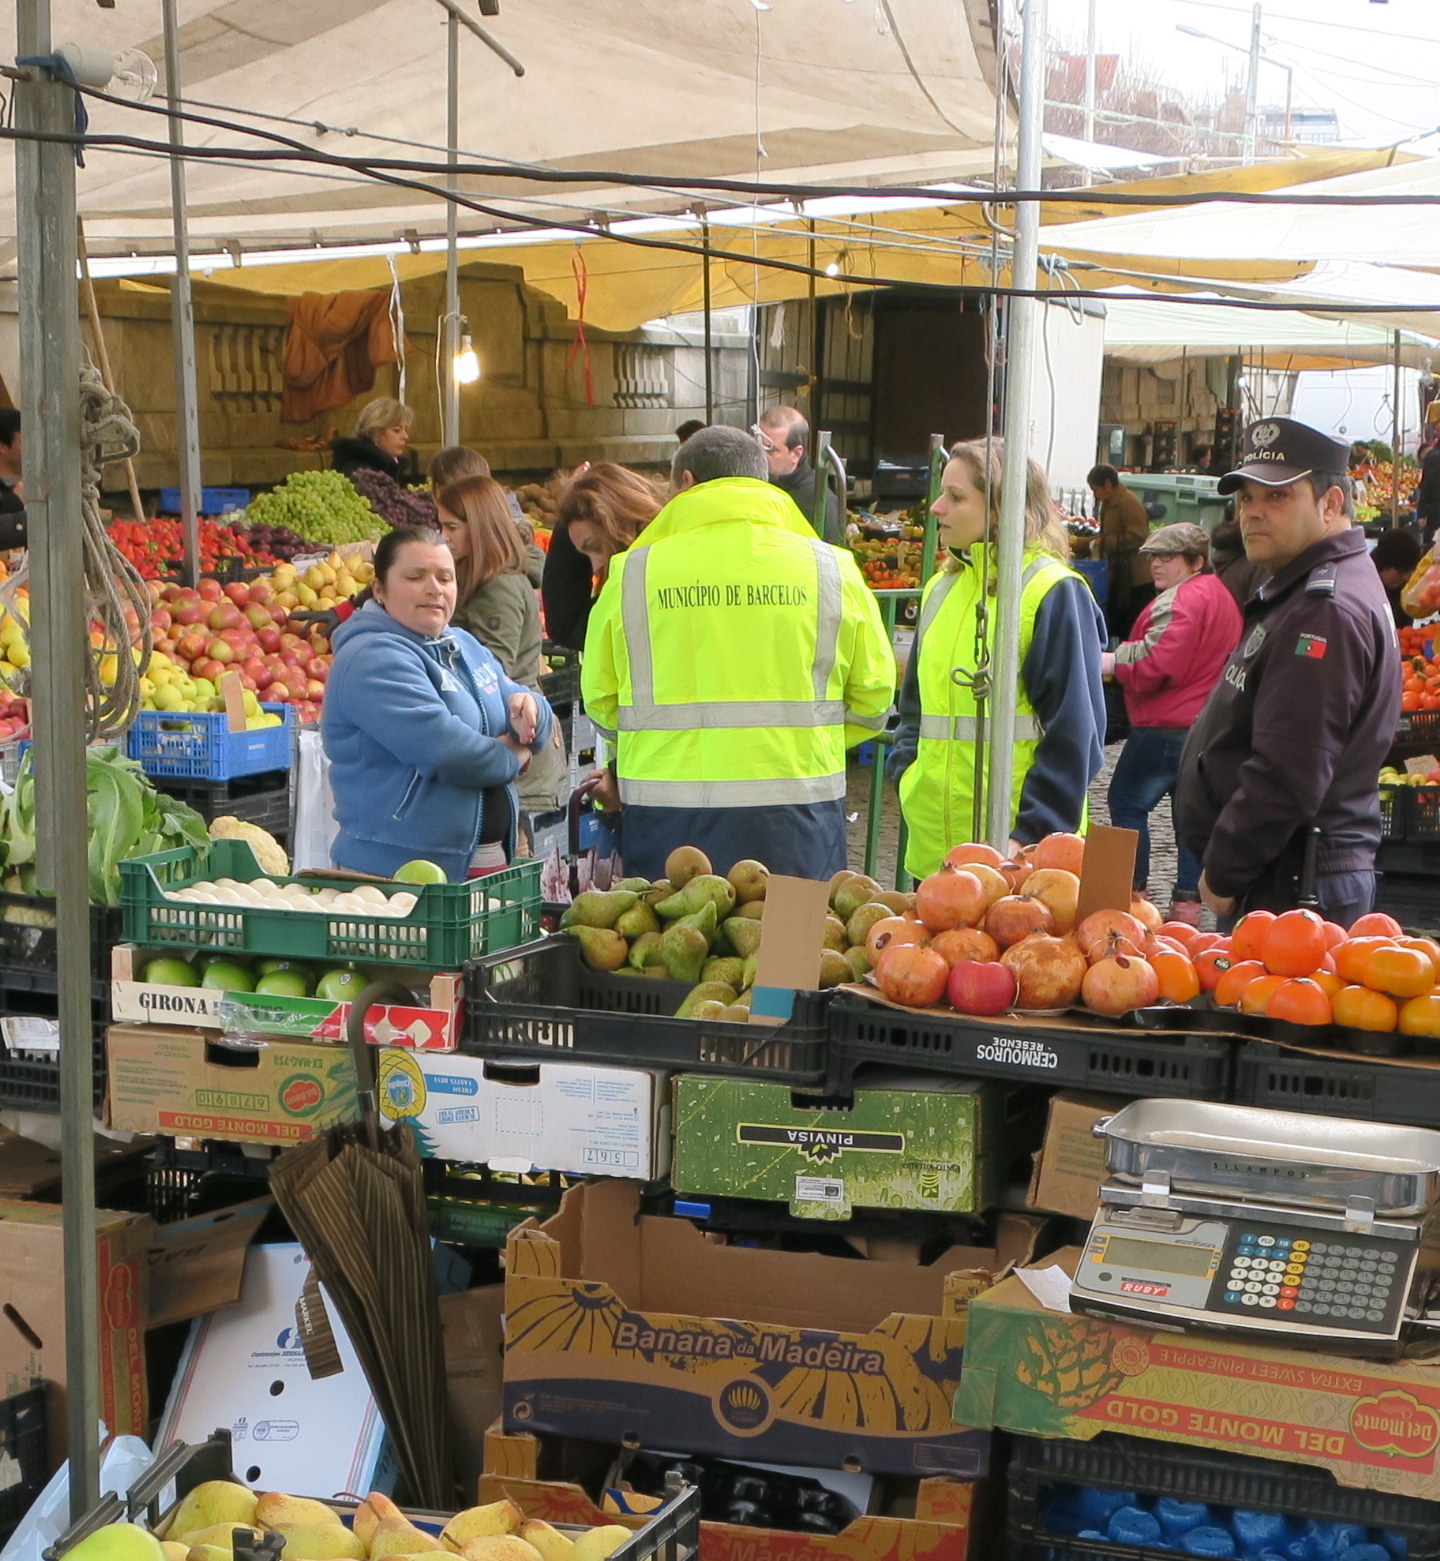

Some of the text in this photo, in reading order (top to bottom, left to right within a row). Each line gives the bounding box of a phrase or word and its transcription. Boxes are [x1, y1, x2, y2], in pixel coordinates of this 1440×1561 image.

[1244, 448, 1285, 463] POLÍCIA
[657, 579, 807, 609] MUNICÍPIO DE BARCELOS
[139, 992, 211, 1016] GIRONA
[992, 1037, 1044, 1052] RESENDE
[976, 1045, 1058, 1069] CERMOUROS
[199, 1093, 266, 1109] 6 7 8 9 10
[174, 1116, 301, 1138] DEL MONTE GOLD
[786, 1130, 854, 1146] PINVISA
[587, 1151, 622, 1163] 5 6 7
[1213, 1162, 1306, 1179] SILAMPOS
[1123, 1283, 1163, 1296] RUBY
[616, 1321, 731, 1356] Banana
[737, 1341, 755, 1355] da
[128, 1327, 143, 1436] DEL MONT
[1158, 1350, 1363, 1391] EXTRA SWEET PINEAPPLE
[1106, 1400, 1346, 1455] DEL MONTE GOLD
[1354, 1414, 1433, 1441] Del Monte
